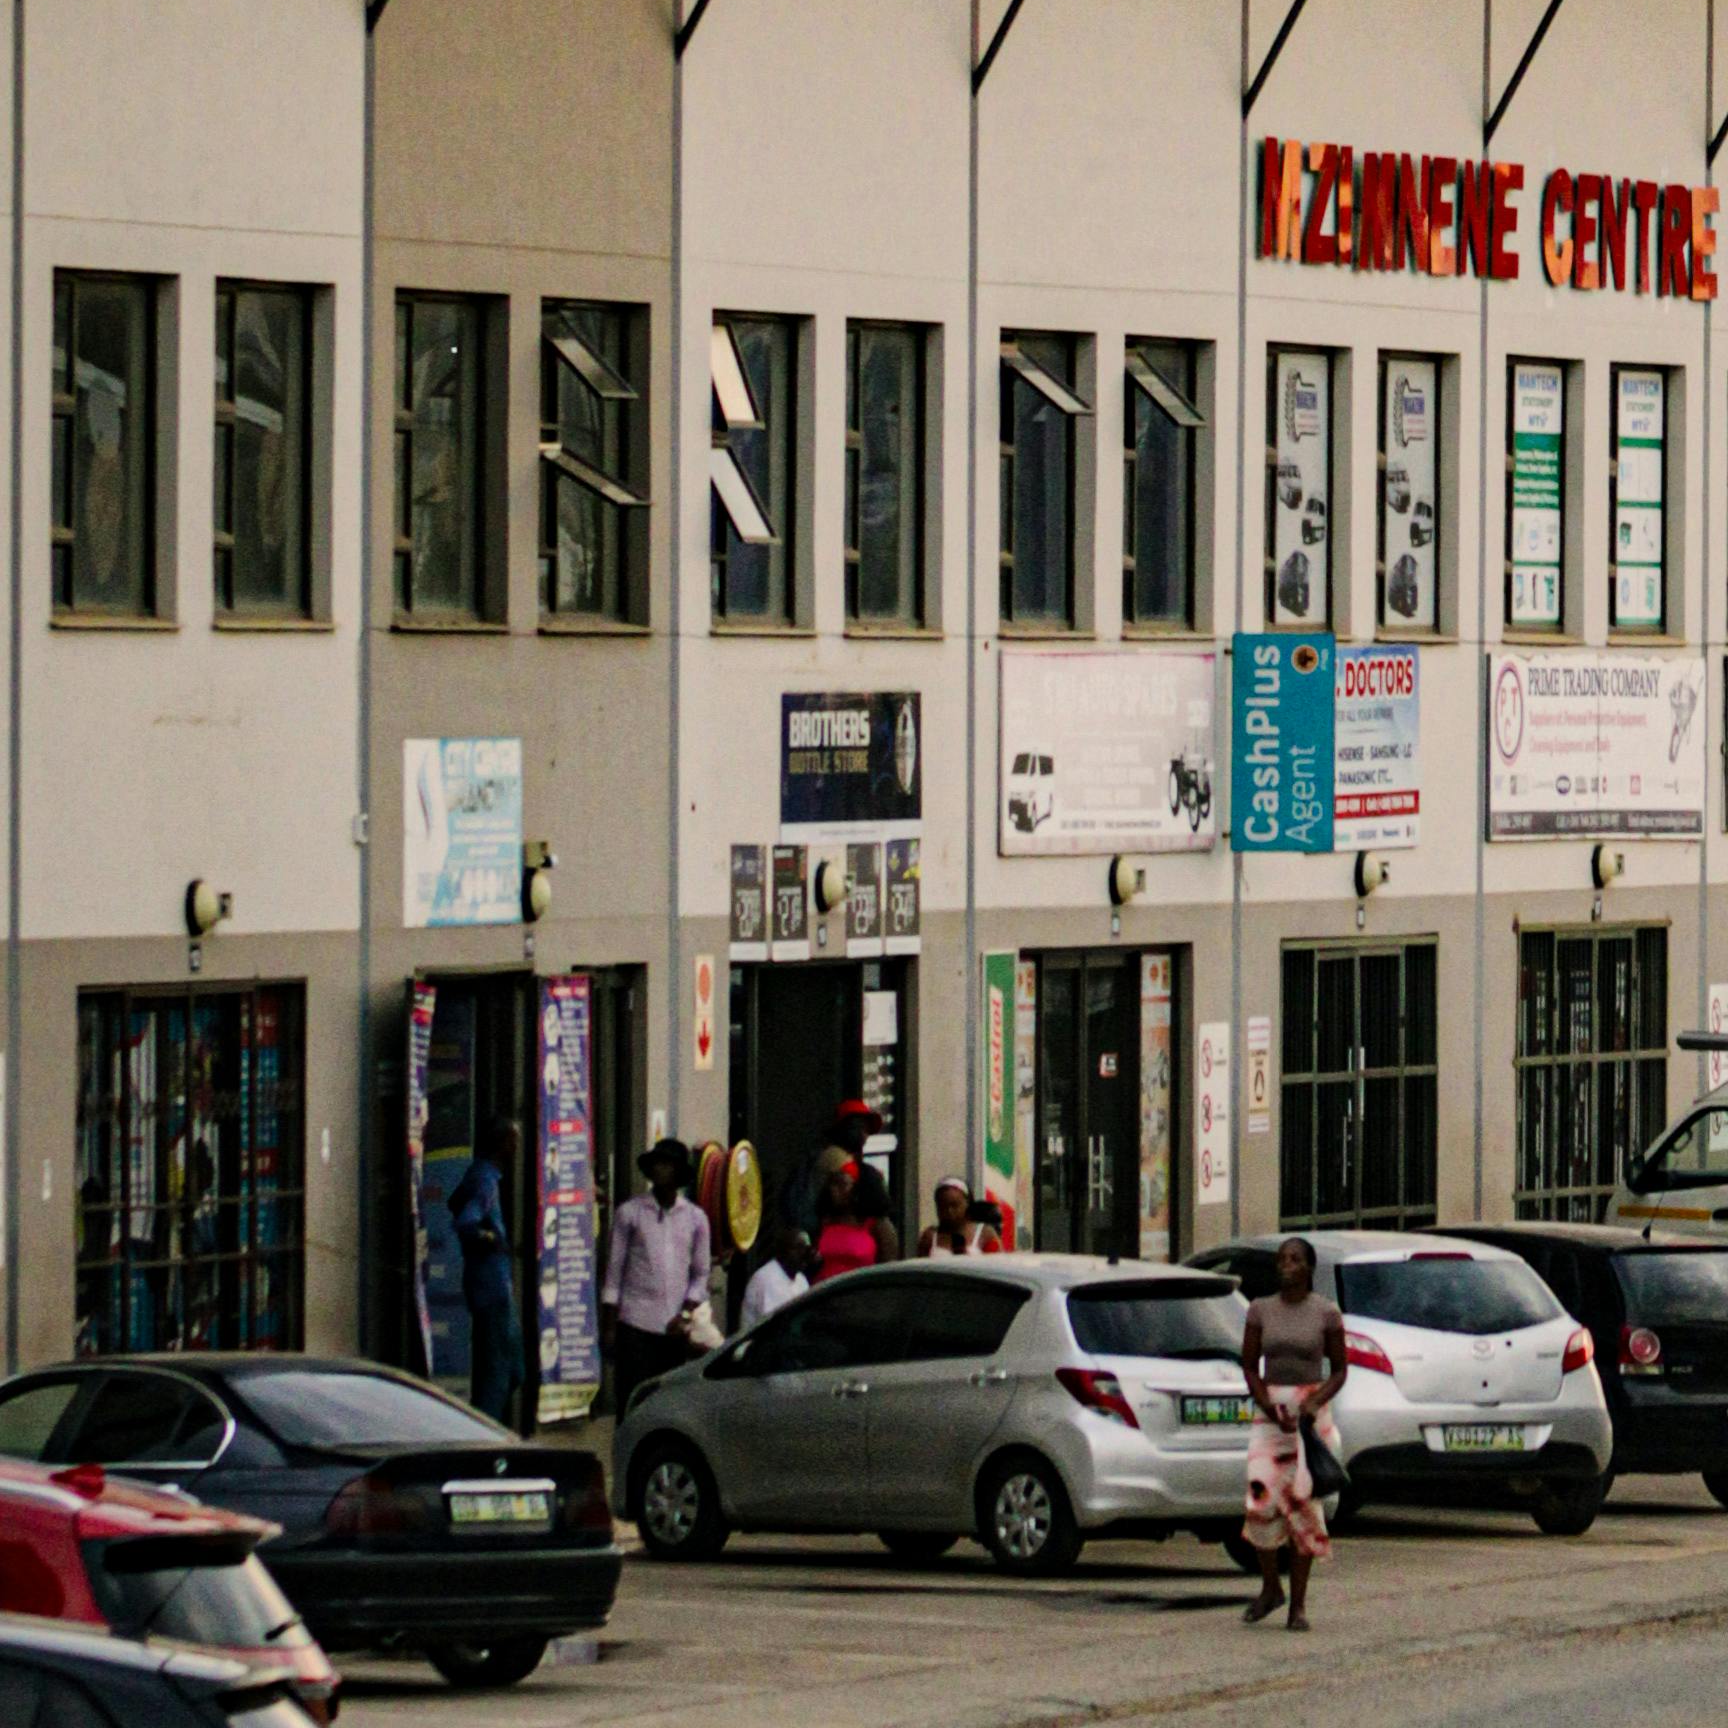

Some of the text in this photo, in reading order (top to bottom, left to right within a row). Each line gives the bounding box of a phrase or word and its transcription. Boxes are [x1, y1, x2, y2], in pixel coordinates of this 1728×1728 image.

[1261, 136, 1720, 301] MZIMNENE CENTRE
[1345, 659, 1413, 697] DOCTORS
[1528, 668, 1660, 698] PRIME TRADING COMPANY
[789, 710, 870, 748] BROTHERS
[1243, 644, 1281, 843] CashPlus
[1284, 745, 1324, 844] Agent
